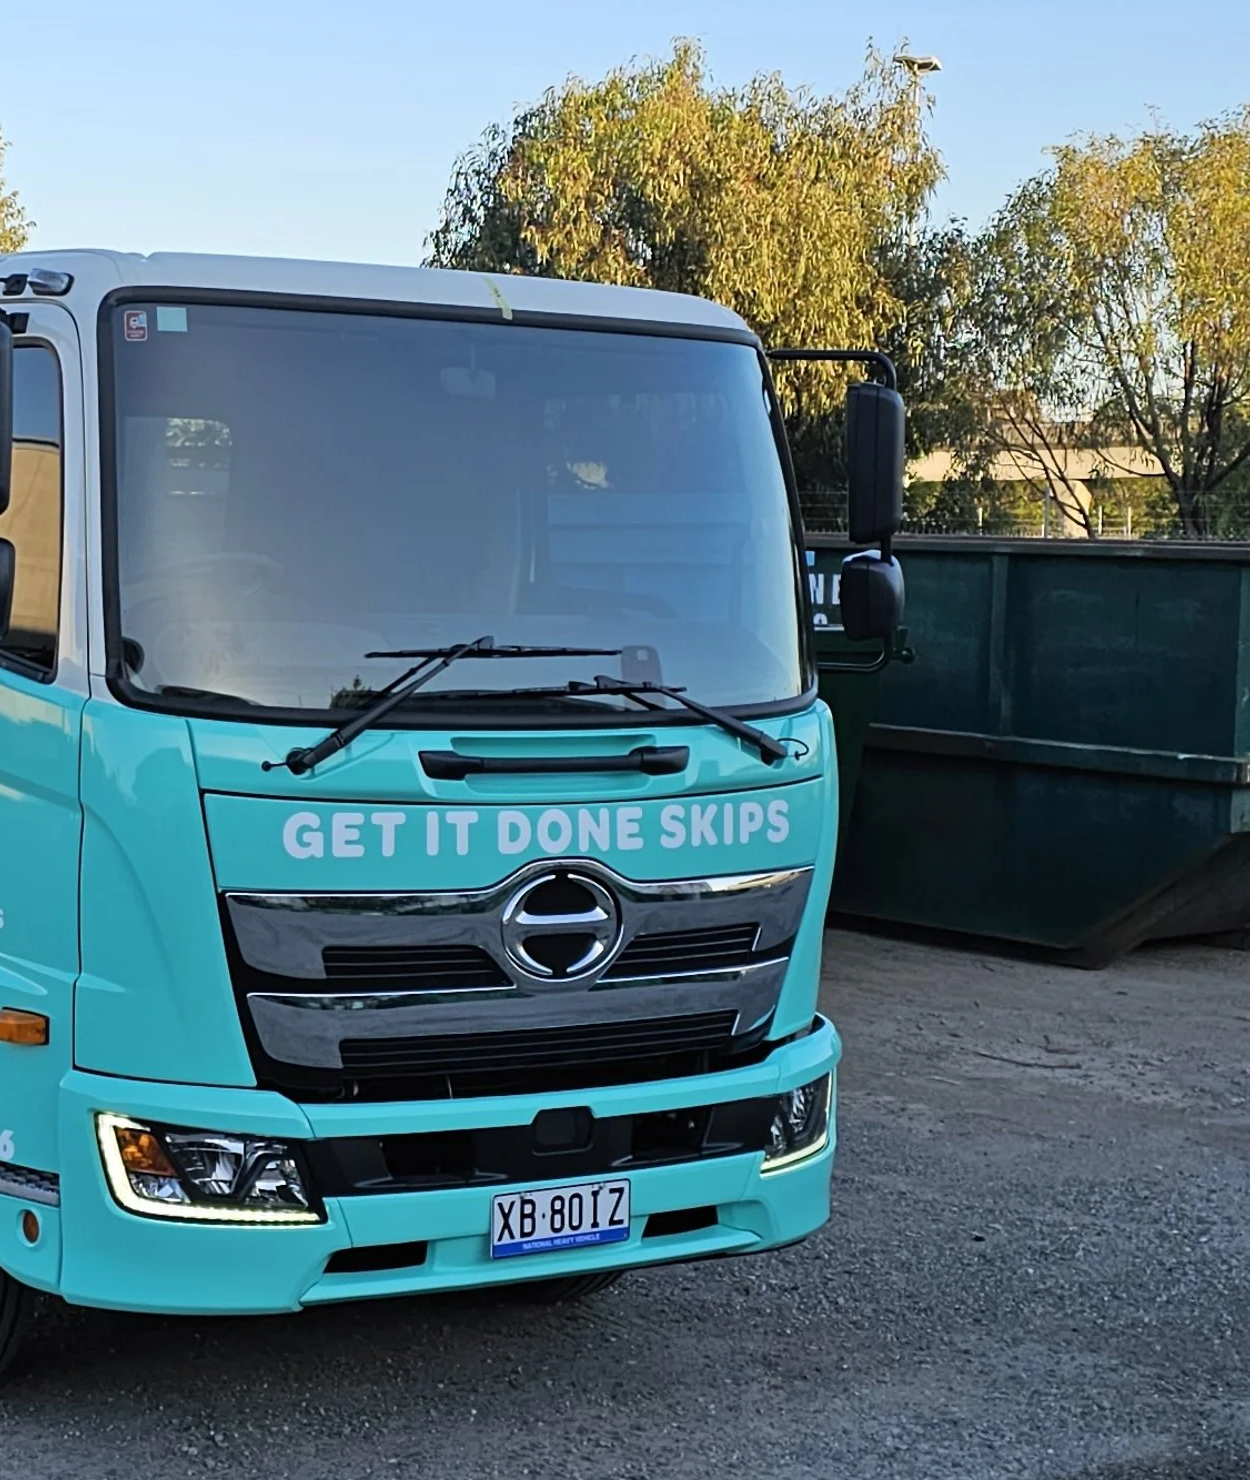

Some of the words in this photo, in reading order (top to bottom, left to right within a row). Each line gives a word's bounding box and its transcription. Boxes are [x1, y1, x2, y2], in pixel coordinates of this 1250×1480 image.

[282, 811, 407, 860] GET
[426, 810, 479, 857] IT
[497, 806, 644, 855] DONE
[659, 799, 790, 849] SKIPS
[553, 1236, 575, 1246] HEAVY
[575, 1233, 601, 1243] VEHICLE
